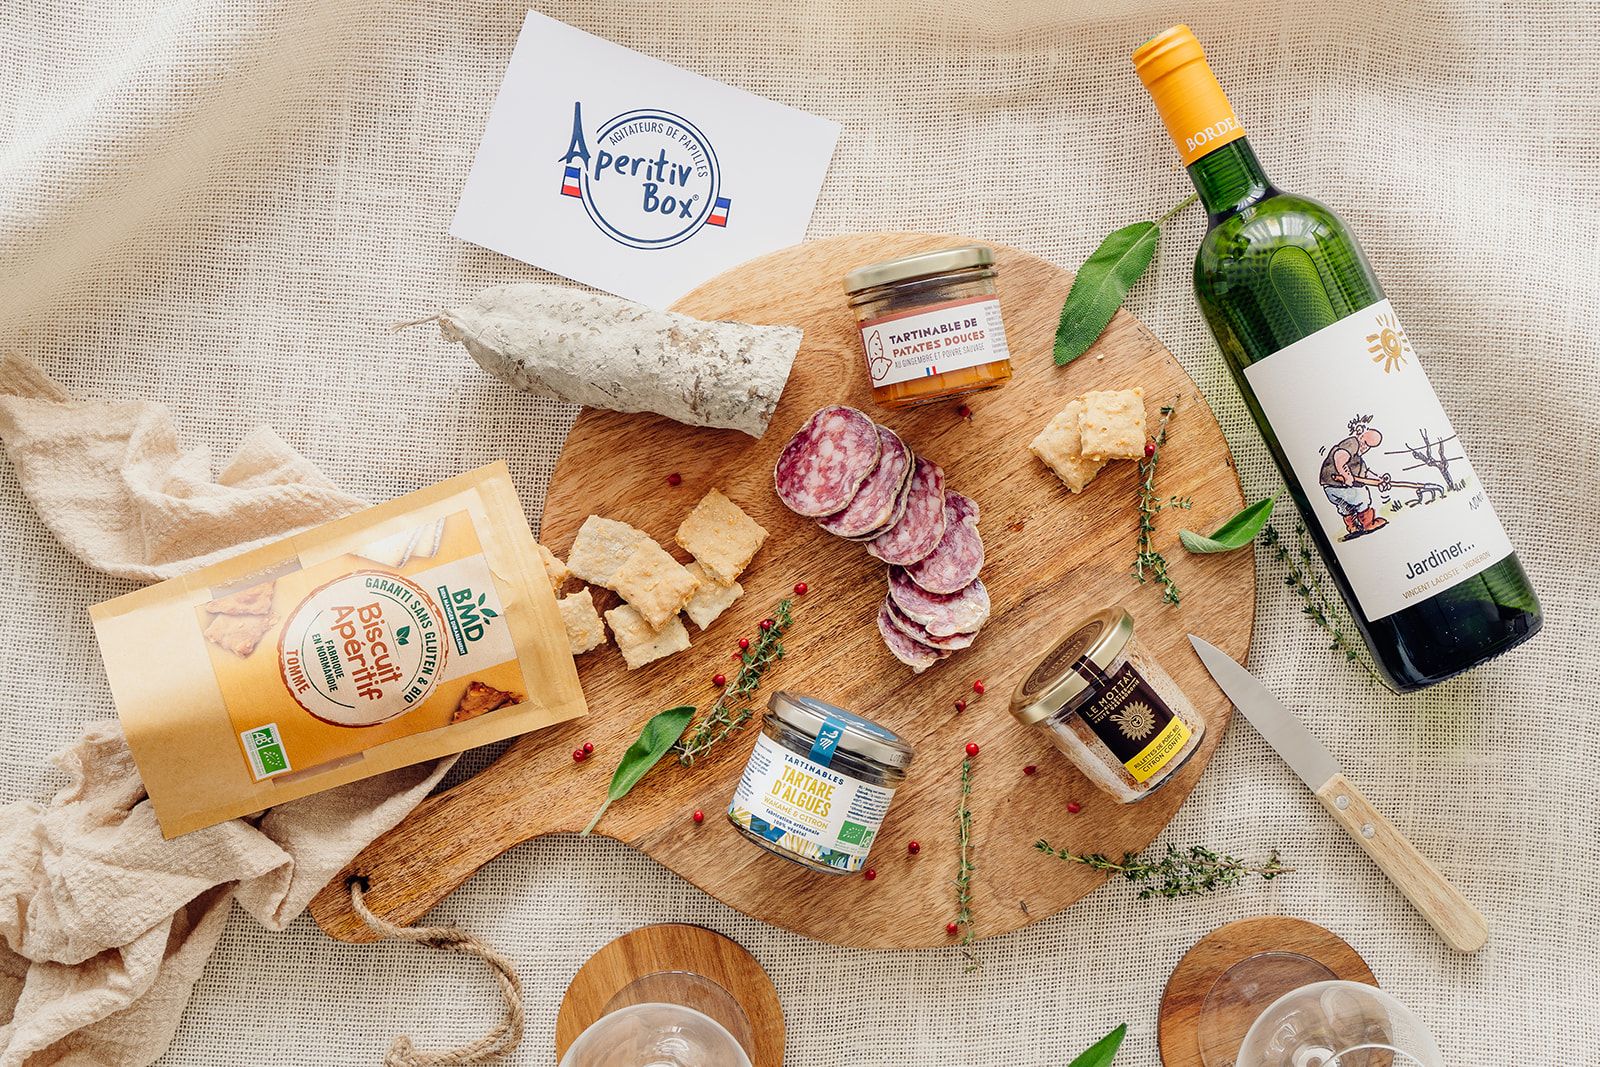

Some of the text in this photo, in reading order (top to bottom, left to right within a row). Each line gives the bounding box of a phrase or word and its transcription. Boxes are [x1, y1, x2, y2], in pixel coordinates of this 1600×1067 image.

[608, 122, 708, 178] AGITATEURS DE PAPILLES
[889, 317, 978, 345] TARTINABLE DE
[892, 330, 986, 358] PATATES DOUCES
[933, 351, 941, 361] ET
[941, 346, 963, 359] POIVRE
[962, 342, 986, 355] SAUVAGE
[1401, 581, 1431, 600] VINCENT
[1430, 567, 1461, 587] LACOSTE
[1462, 551, 1492, 571] VIGNERON
[1405, 541, 1475, 580] Jardiner...
[452, 588, 485, 642] BMD
[324, 639, 346, 680] FABRIQUE
[330, 605, 384, 701] Apéritif
[356, 601, 403, 684] Biscuit
[365, 577, 438, 704] GARANTI SANS GLUTEN & BIO
[286, 648, 311, 695] TOMME
[311, 633, 339, 693] EN NORMANDIE
[1085, 670, 1133, 718] LE MOTTAY
[1142, 733, 1183, 773] CITRON CONFIT
[1161, 731, 1174, 745] PORC
[781, 764, 837, 802] TARTARE
[784, 753, 845, 786] TARTINABLES
[770, 779, 832, 818] D'ALGUES
[765, 808, 820, 836] fabrication artisanale
[799, 813, 830, 830] CITRON
